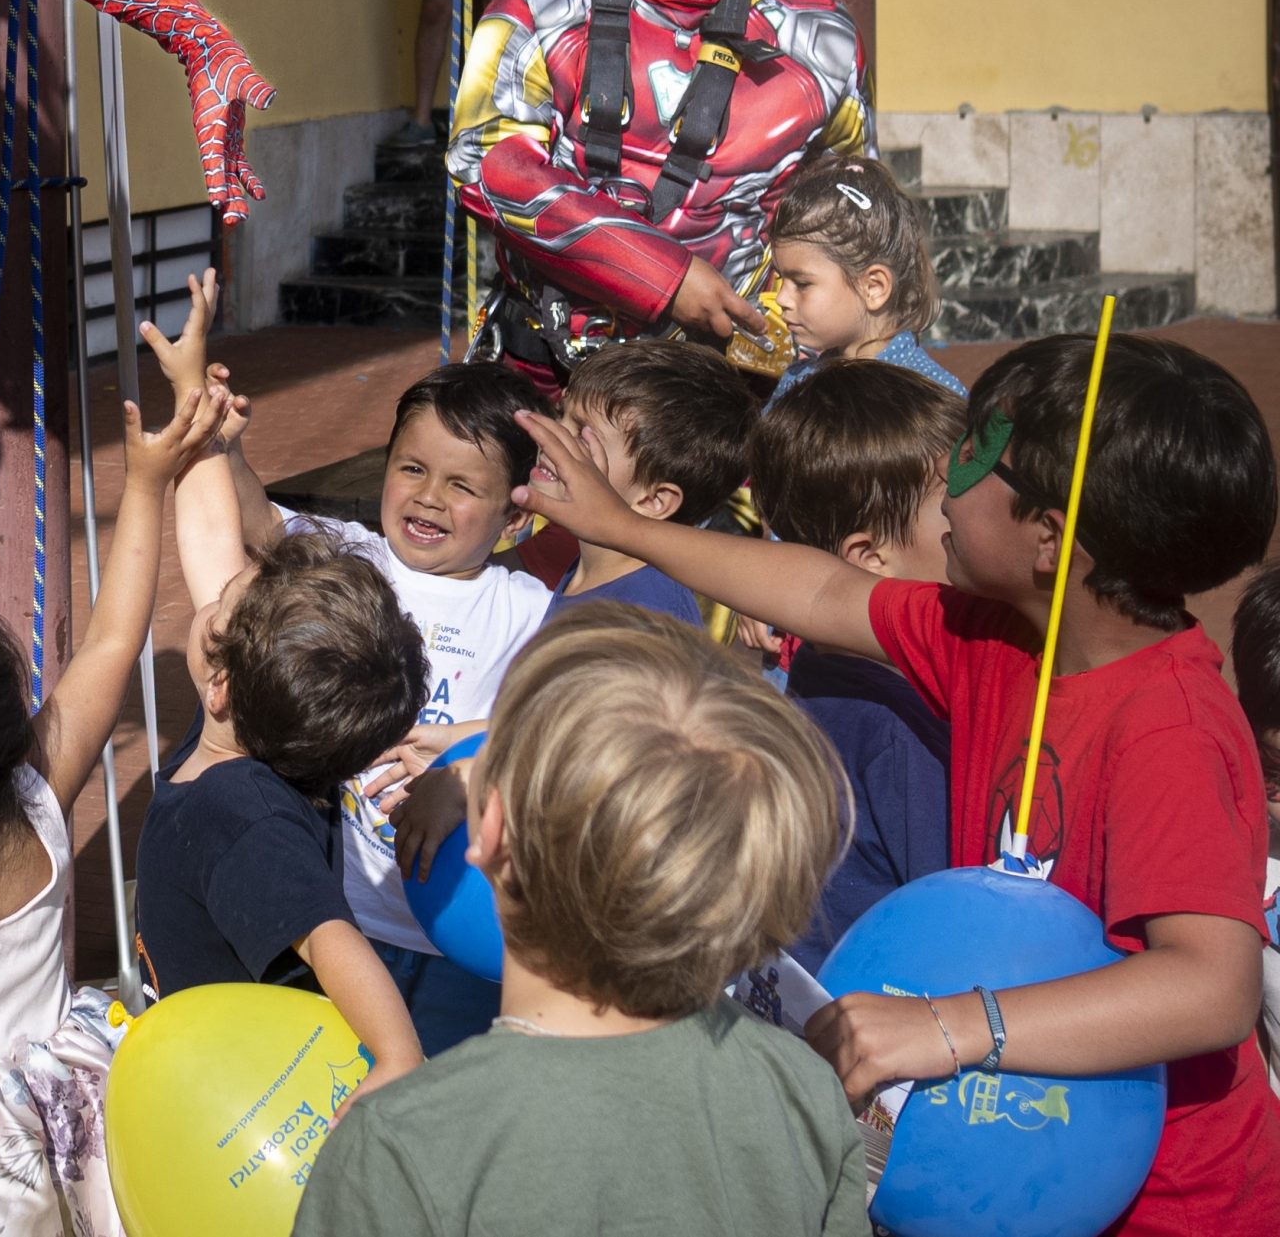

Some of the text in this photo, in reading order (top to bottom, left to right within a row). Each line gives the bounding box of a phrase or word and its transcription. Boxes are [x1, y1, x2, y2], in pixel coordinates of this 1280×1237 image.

[433, 623, 461, 637] SUPER
[431, 631, 451, 644] EROI
[428, 641, 476, 659] ACROBATICI
